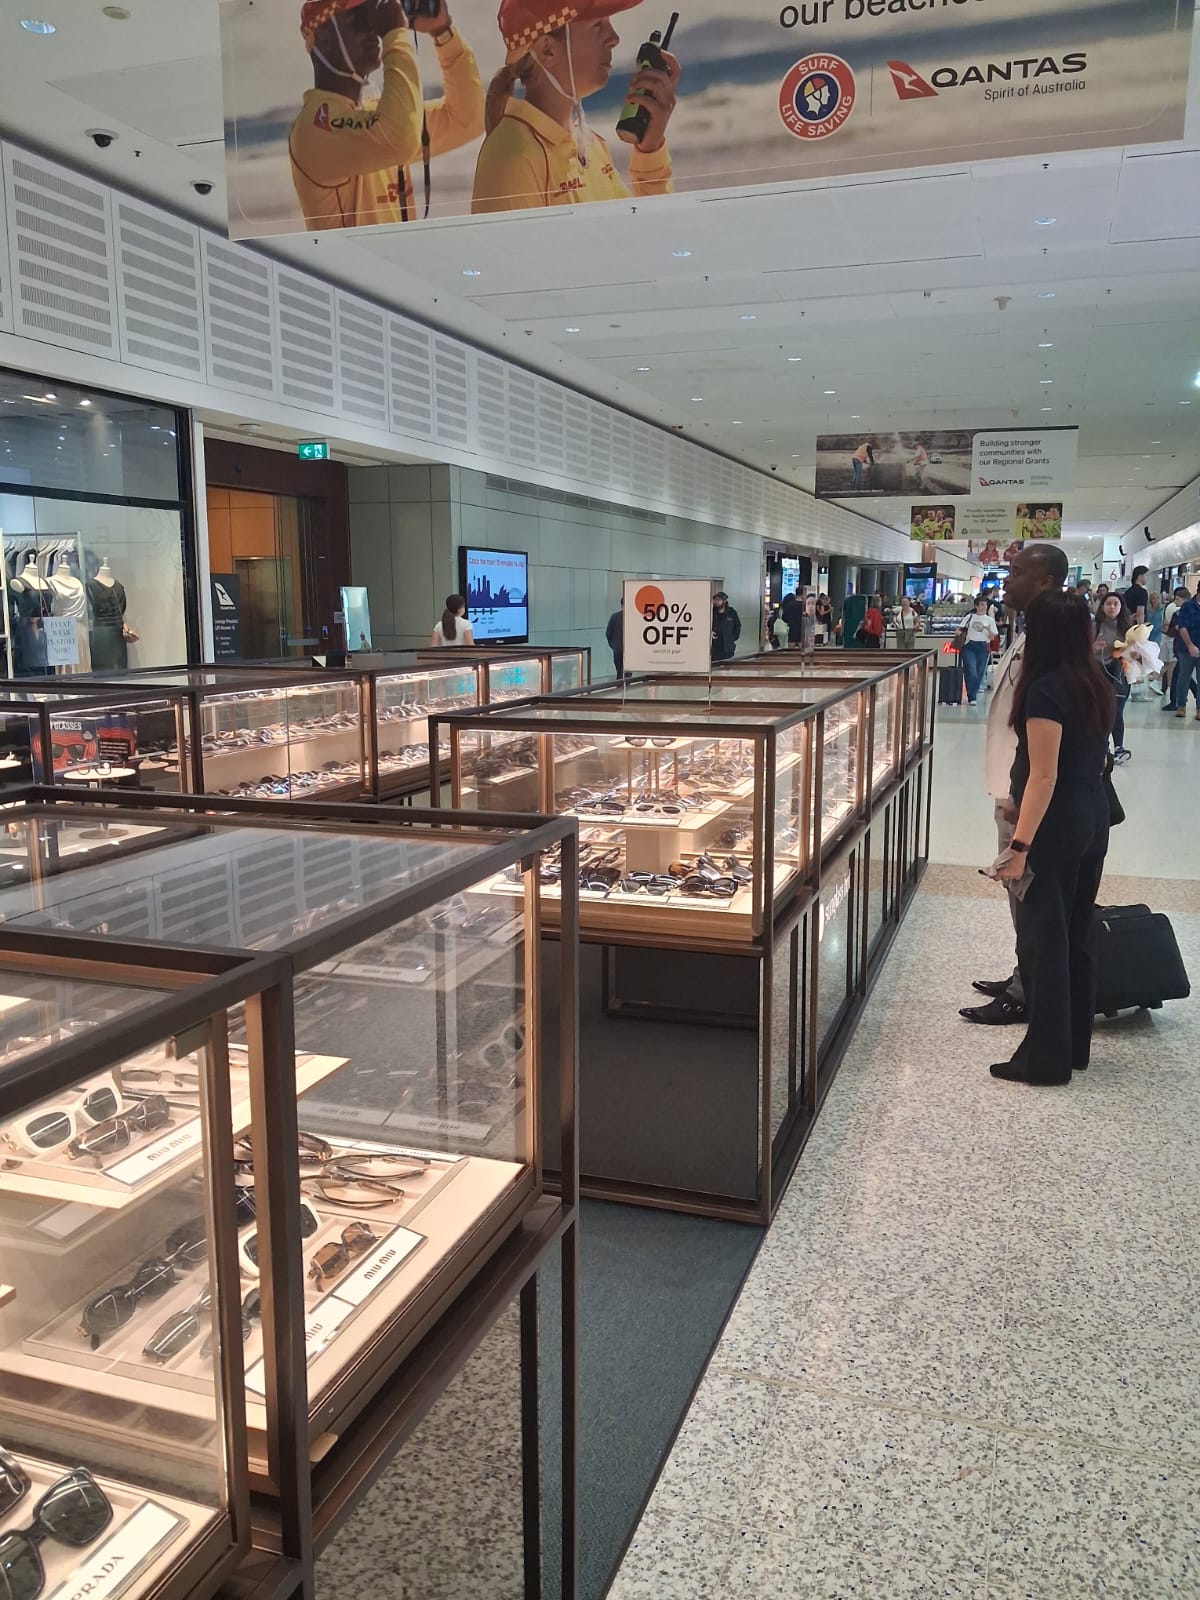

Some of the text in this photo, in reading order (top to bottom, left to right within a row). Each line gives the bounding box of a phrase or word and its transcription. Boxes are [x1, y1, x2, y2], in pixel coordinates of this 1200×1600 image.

[780, 0, 835, 28] our
[798, 58, 840, 75] SURF
[930, 53, 1088, 88] QANTAS
[984, 79, 1086, 102] Spirit of Australia
[782, 95, 852, 136] LIFE SAVING
[1010, 439, 1041, 447] stronger
[992, 458, 1024, 466] Regional
[1110, 569, 1117, 580] 6
[643, 602, 692, 623] 50%
[53, 721, 82, 731] GLASSES
[364, 1249, 397, 1280] MIU MIU
[70, 1556, 125, 1600] PRADA
